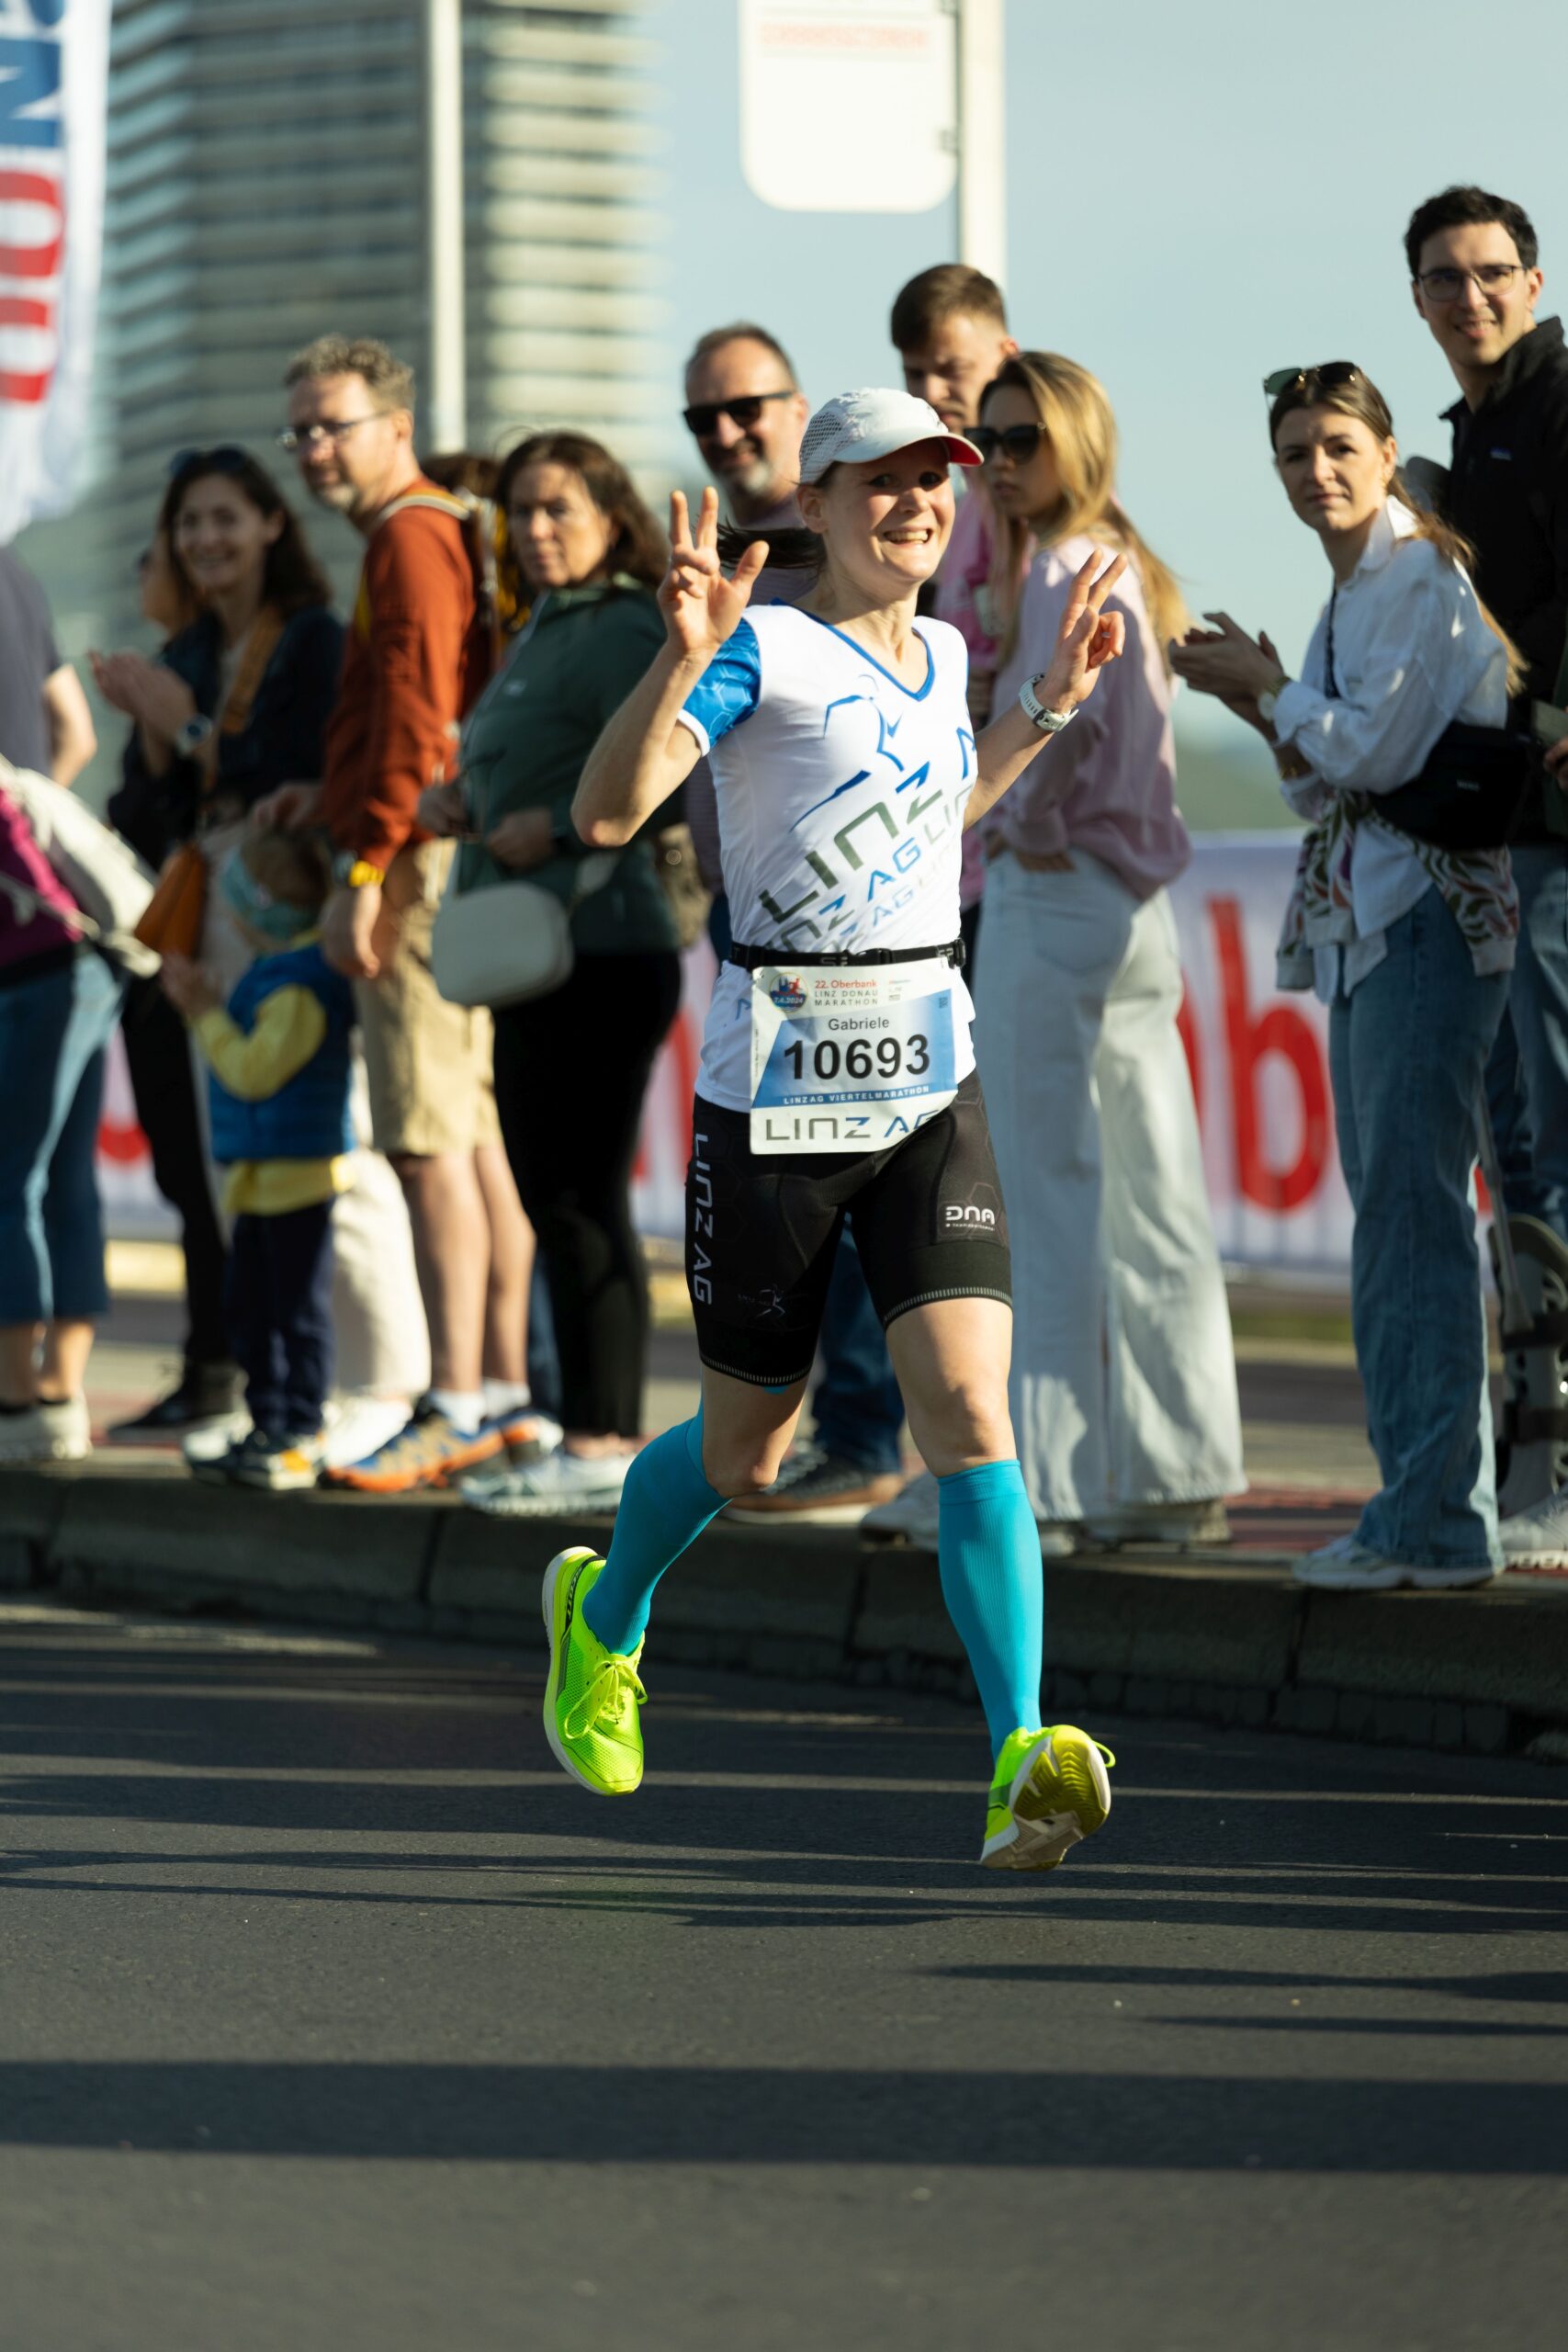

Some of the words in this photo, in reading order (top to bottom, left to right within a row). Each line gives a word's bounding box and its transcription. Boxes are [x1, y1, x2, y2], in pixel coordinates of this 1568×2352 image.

[759, 761, 943, 924] LINZ
[867, 836, 922, 903] AG
[872, 885, 915, 928] AG
[815, 980, 829, 989] 22.
[830, 979, 877, 989] Oberbank
[841, 989, 878, 998] DONAU
[828, 1017, 890, 1031] Gabriele
[784, 1034, 931, 1080] 10693
[829, 1085, 930, 1102] VIERTELMARATHON
[765, 1116, 871, 1141] LINZ
[695, 1133, 713, 1238] LINZ
[945, 1205, 996, 1226] DNA
[694, 1242, 712, 1306] AG
